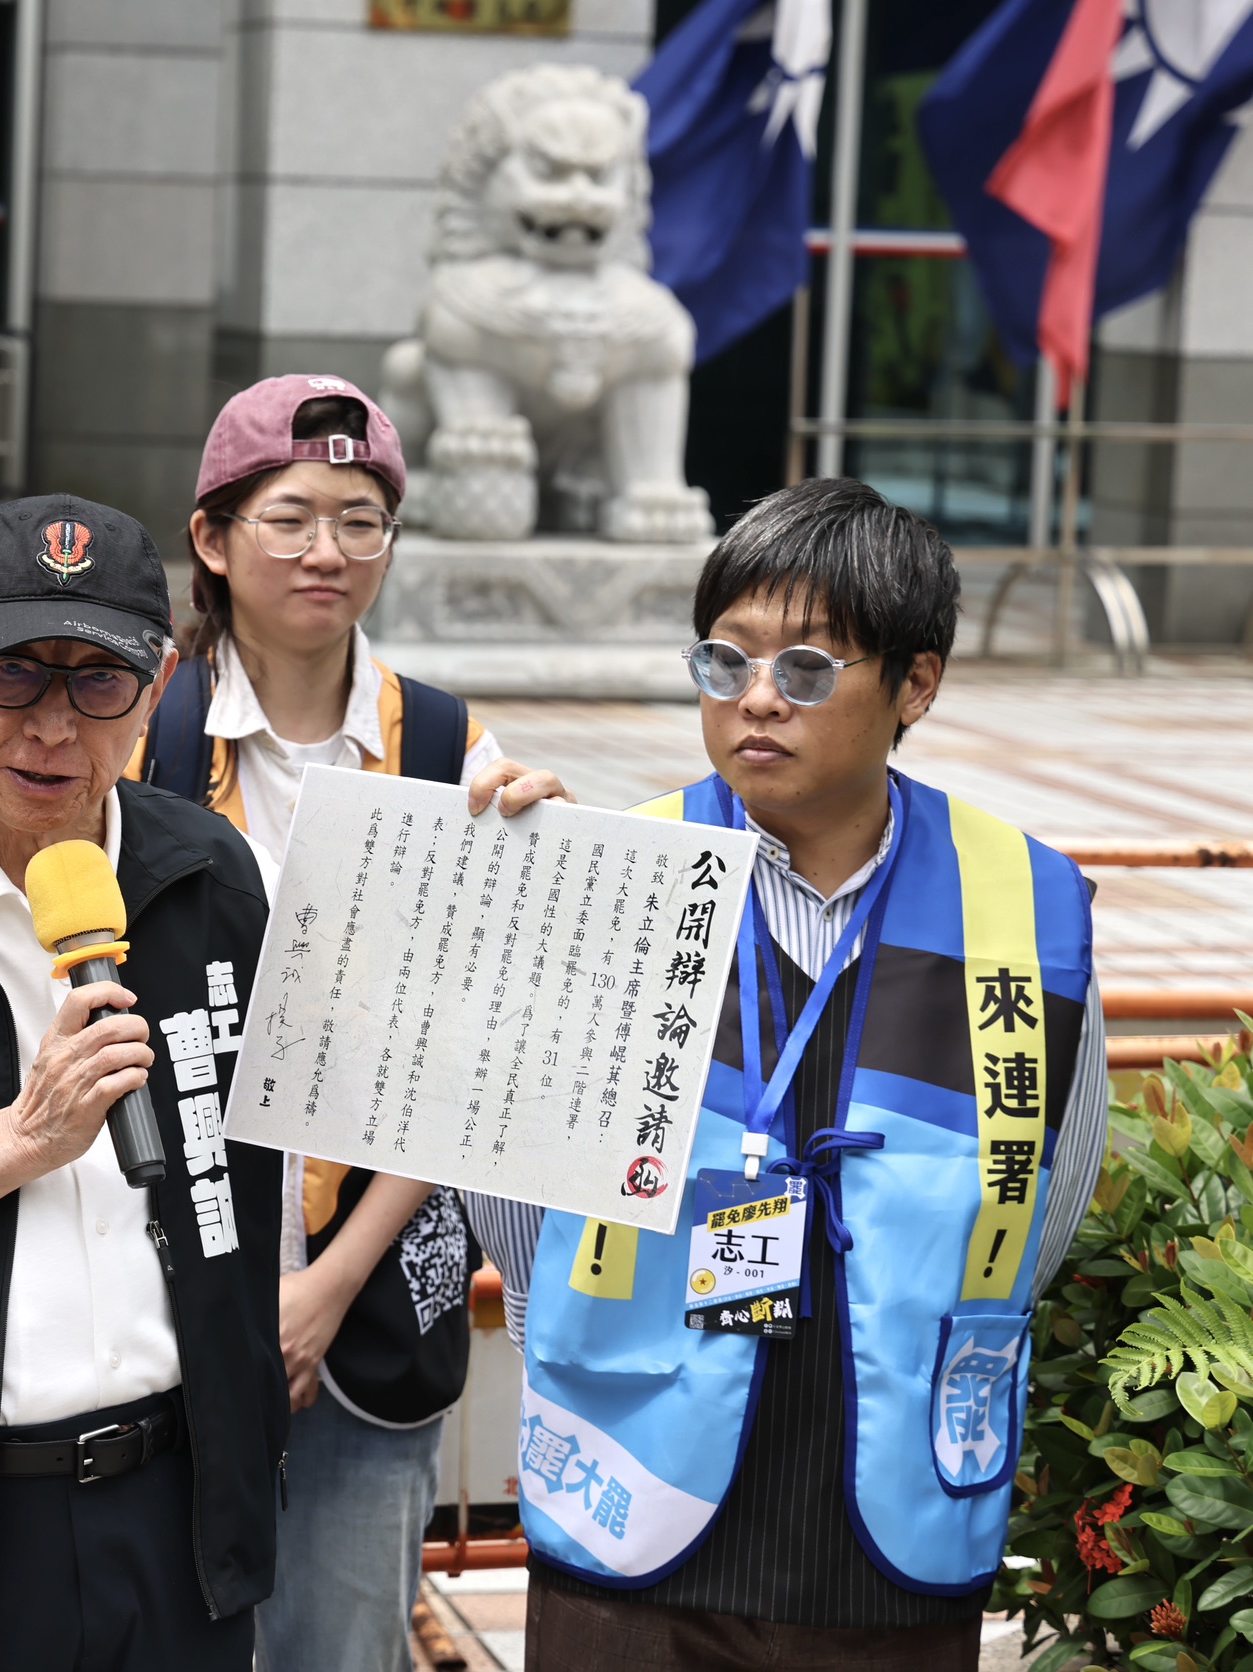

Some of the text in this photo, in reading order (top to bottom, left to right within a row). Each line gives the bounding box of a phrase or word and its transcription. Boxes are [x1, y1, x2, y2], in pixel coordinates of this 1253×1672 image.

[590, 971, 617, 991] 130
[205, 960, 243, 1055] 志工
[542, 1050, 559, 1067] 31
[258, 1077, 276, 1107] 敬上
[975, 967, 1040, 1278] 來連署！
[710, 1197, 788, 1230] 罷免廖先翔
[711, 1229, 780, 1267] 志工
[520, 1412, 633, 1540] 罷大罷
